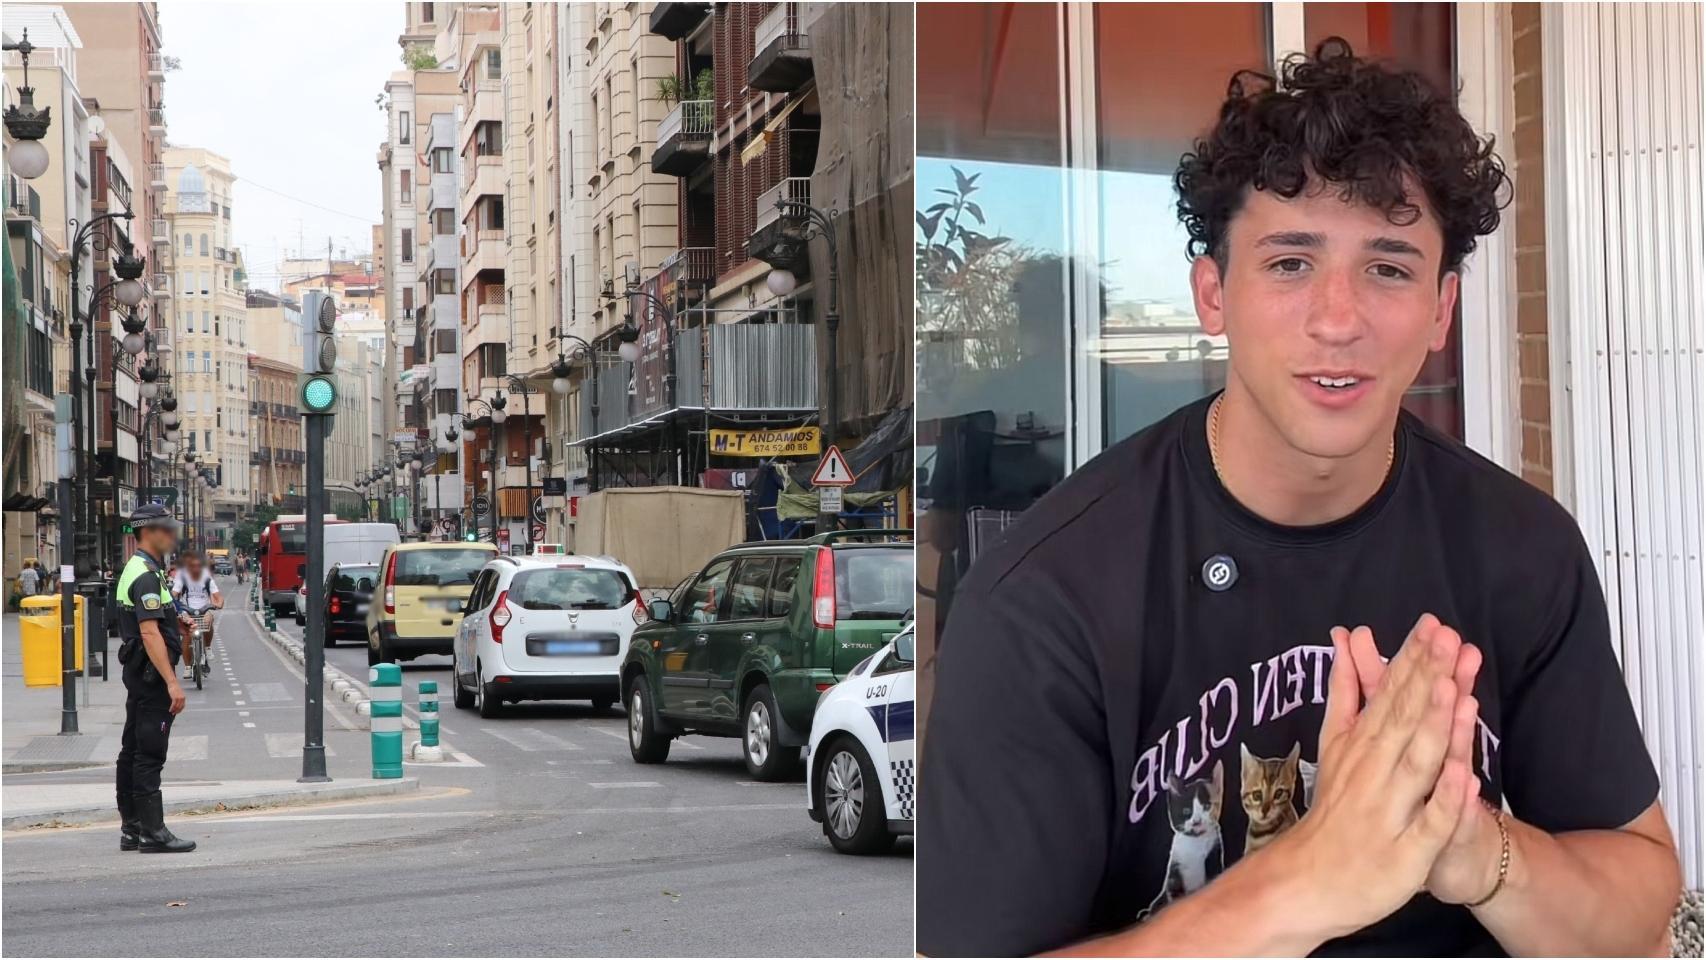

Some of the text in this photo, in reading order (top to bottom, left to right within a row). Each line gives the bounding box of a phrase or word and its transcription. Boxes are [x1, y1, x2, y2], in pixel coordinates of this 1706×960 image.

[714, 431, 813, 452] M-T ANDAMIOS
[754, 444, 770, 453] 674
[772, 444, 784, 452] 52
[785, 442, 795, 452] 00
[841, 642, 874, 650] X-TRAIL
[866, 684, 888, 700] U-20
